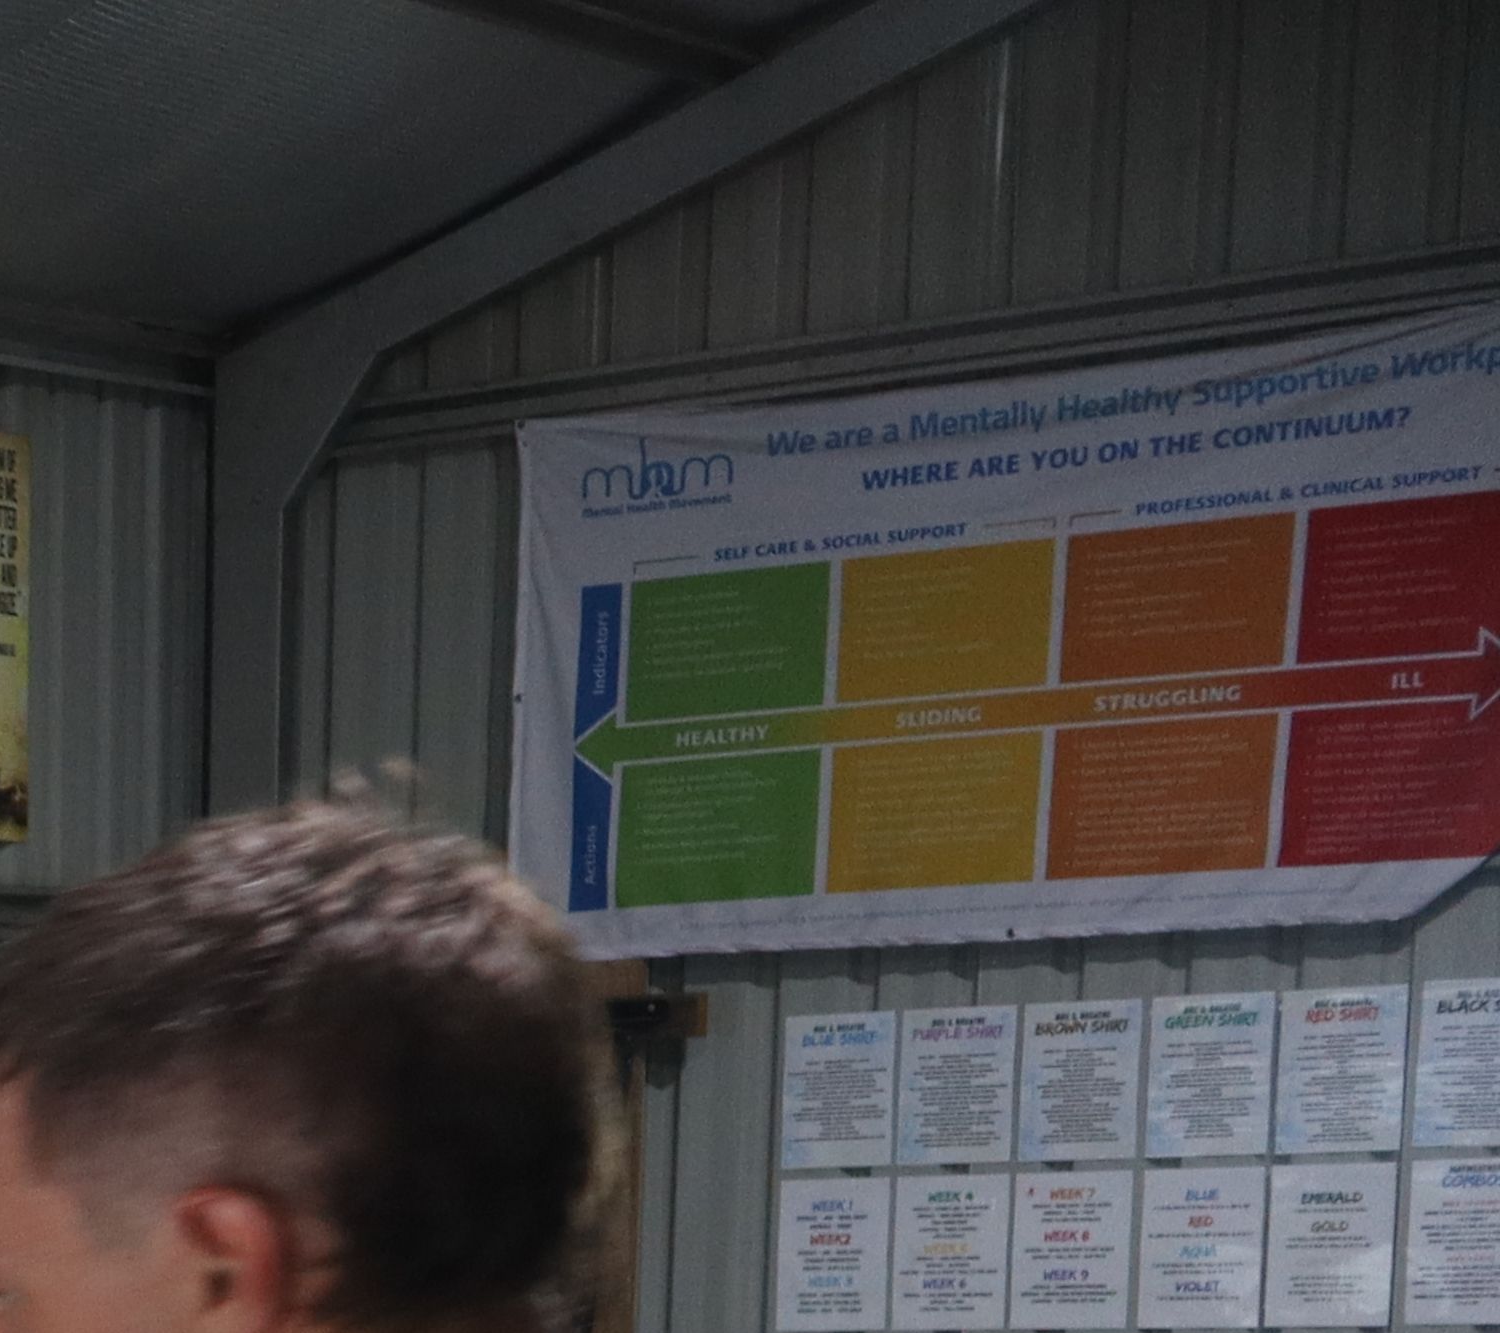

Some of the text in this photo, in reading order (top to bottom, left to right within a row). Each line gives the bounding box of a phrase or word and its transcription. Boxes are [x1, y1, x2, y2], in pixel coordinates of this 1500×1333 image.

[766, 431, 817, 457] We
[825, 424, 874, 450] are
[882, 420, 899, 445] a
[908, 400, 1048, 442] Mentally
[1056, 386, 1182, 424] Healthy
[1193, 360, 1380, 408] Supportive
[862, 405, 1412, 492] WHERE ARE YOU ON THE CONTINUUM?
[1134, 488, 1274, 517] PROFESSIONAL
[1301, 477, 1384, 499] CLINICAL
[1391, 464, 1483, 490] SUPPORT
[713, 546, 749, 562] SELF
[754, 541, 798, 557] CARE
[822, 532, 881, 550] SOCIAL
[886, 522, 968, 544] SUPPORT
[1390, 671, 1425, 690] ILL
[1092, 685, 1243, 714] STRUGGLING
[895, 706, 982, 730] SLIDING
[675, 724, 770, 748] HEALTHY
